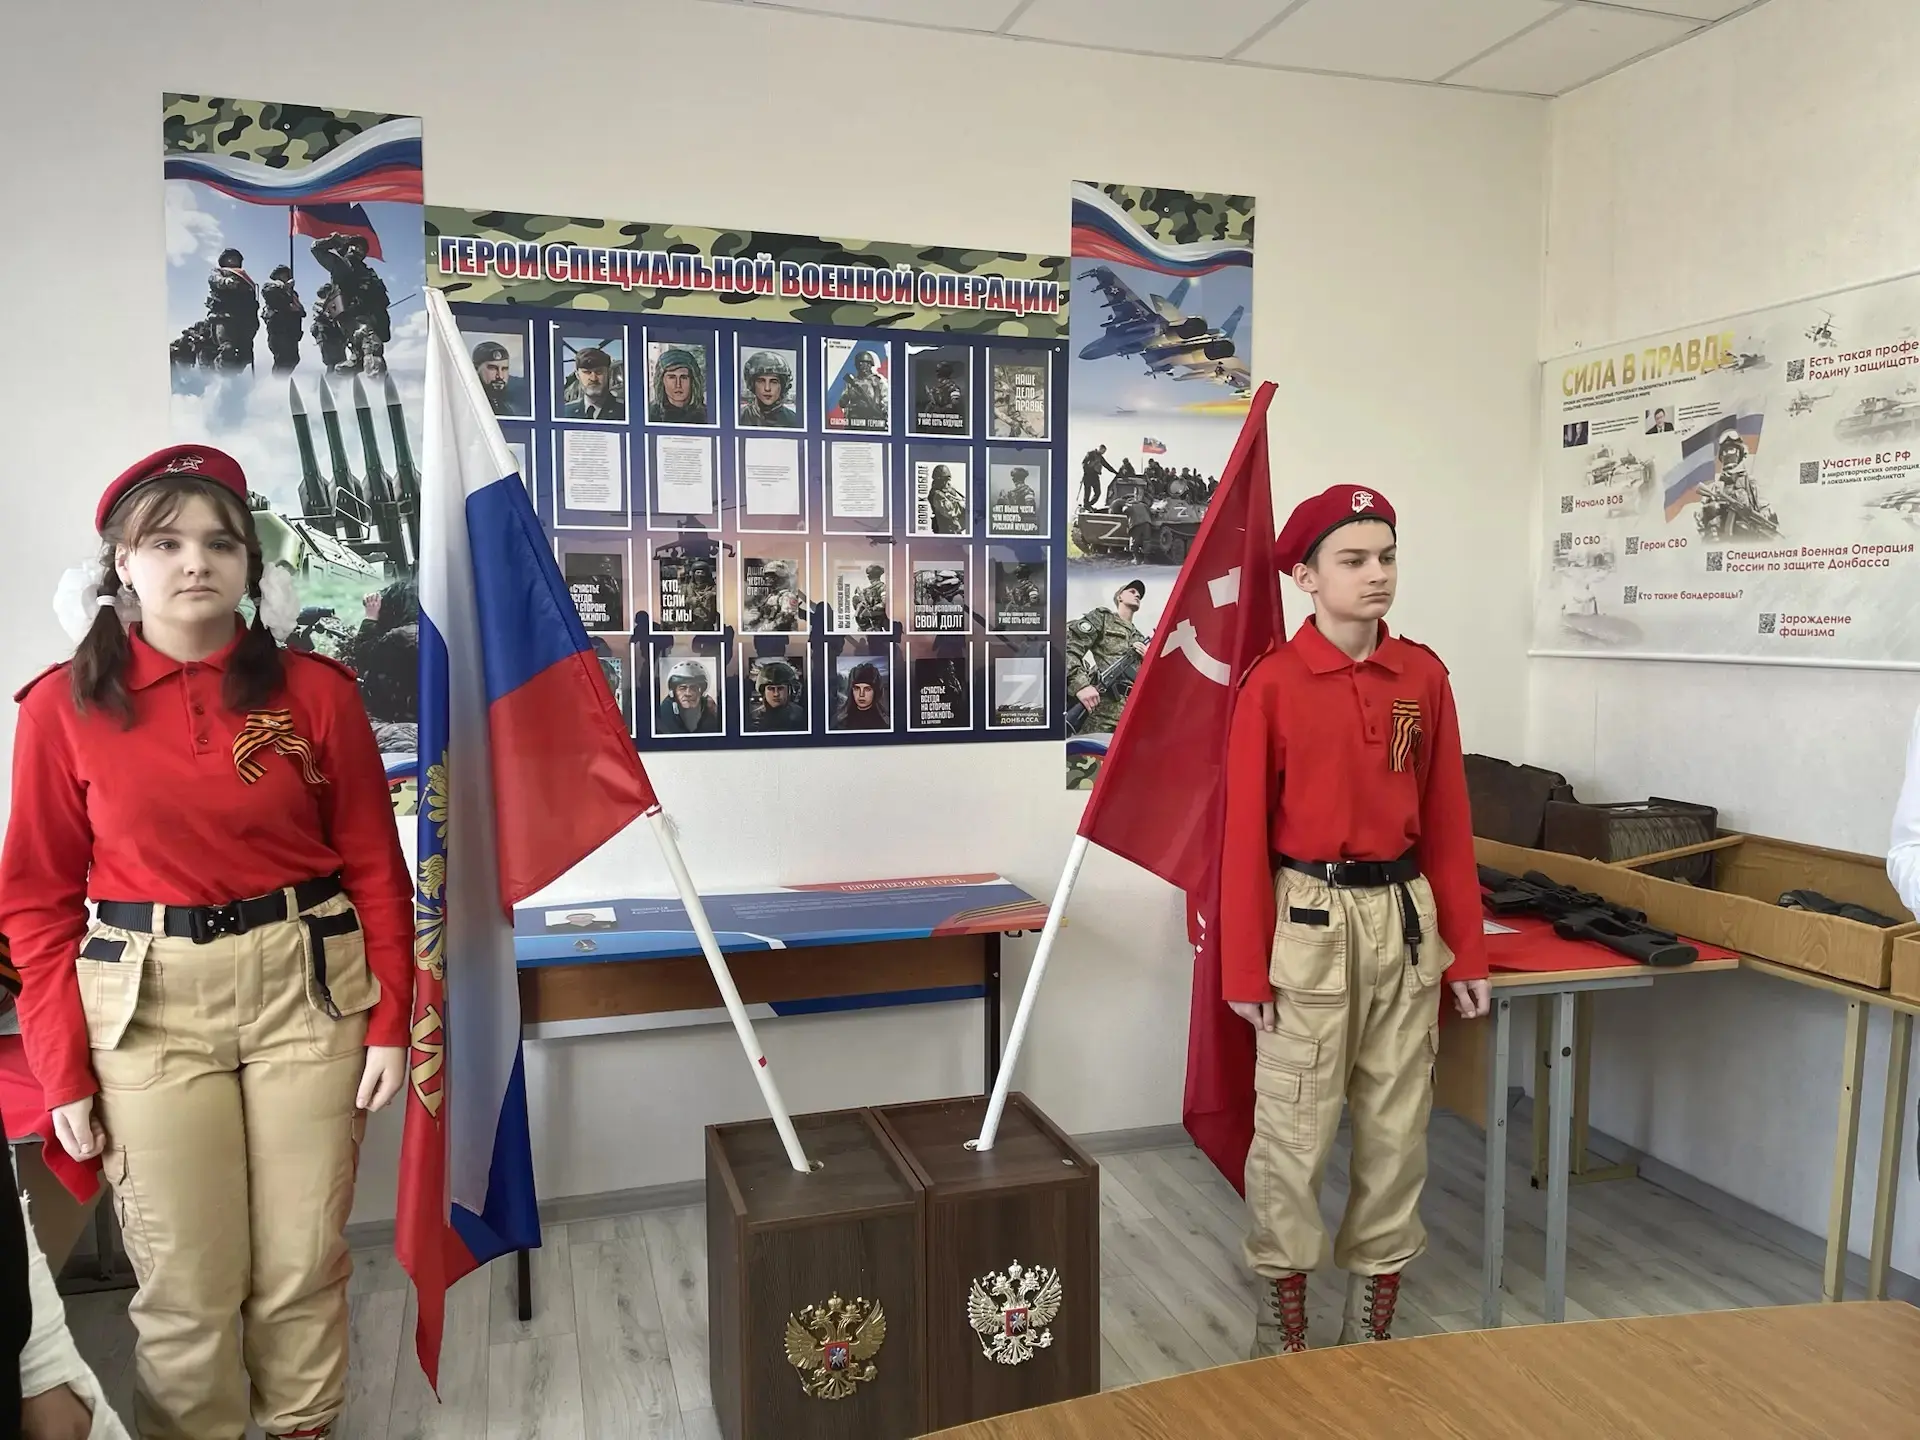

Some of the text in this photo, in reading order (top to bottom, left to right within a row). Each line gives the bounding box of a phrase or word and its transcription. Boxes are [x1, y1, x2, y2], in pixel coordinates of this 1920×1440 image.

[439, 237, 1061, 317] ГЕРОИ СПЕЦИАЛЬНОЙ ВОЕННОЙ ОПЕРАЦИИ
[1562, 331, 1736, 397] СИЛА В ПРАВДЕ
[1809, 356, 1834, 368] Есть
[1838, 349, 1871, 363] такая
[1809, 355, 1920, 381] Родину защищать
[1015, 374, 1036, 386] НАШЕ
[1015, 386, 1035, 399] ДЕЛО
[1015, 399, 1044, 412] ПРАВОЕ
[1823, 451, 1911, 469] Участие ВС РФ
[1827, 468, 1883, 478] миротворческих
[1827, 477, 1862, 485] локальных
[1863, 473, 1906, 482] конфликтах
[918, 465, 929, 495] ПОБЕДЕ
[1575, 495, 1624, 508] Начало ВОВ
[918, 504, 928, 525] ВОЛЯ
[1574, 535, 1600, 545] О СВО
[1640, 538, 1688, 551] Герои СВО
[1726, 543, 1914, 561] Специальная Военная Операция
[1726, 557, 1889, 573] России по защите Донбасса
[662, 579, 681, 594] КТО,
[662, 594, 685, 607] ЕСЛИ
[1638, 589, 1744, 601] Кто такие бандеровцы?
[579, 603, 606, 612] СТОРОНЕ
[663, 609, 692, 622] НЕ МЫ
[915, 613, 963, 630] СВОЙ ДОЛГ
[1779, 613, 1852, 625] Зарождение
[1779, 625, 1836, 638] фашизма
[840, 878, 967, 891] ГЕРОИЧЕСКИЙ ПУТЬ
